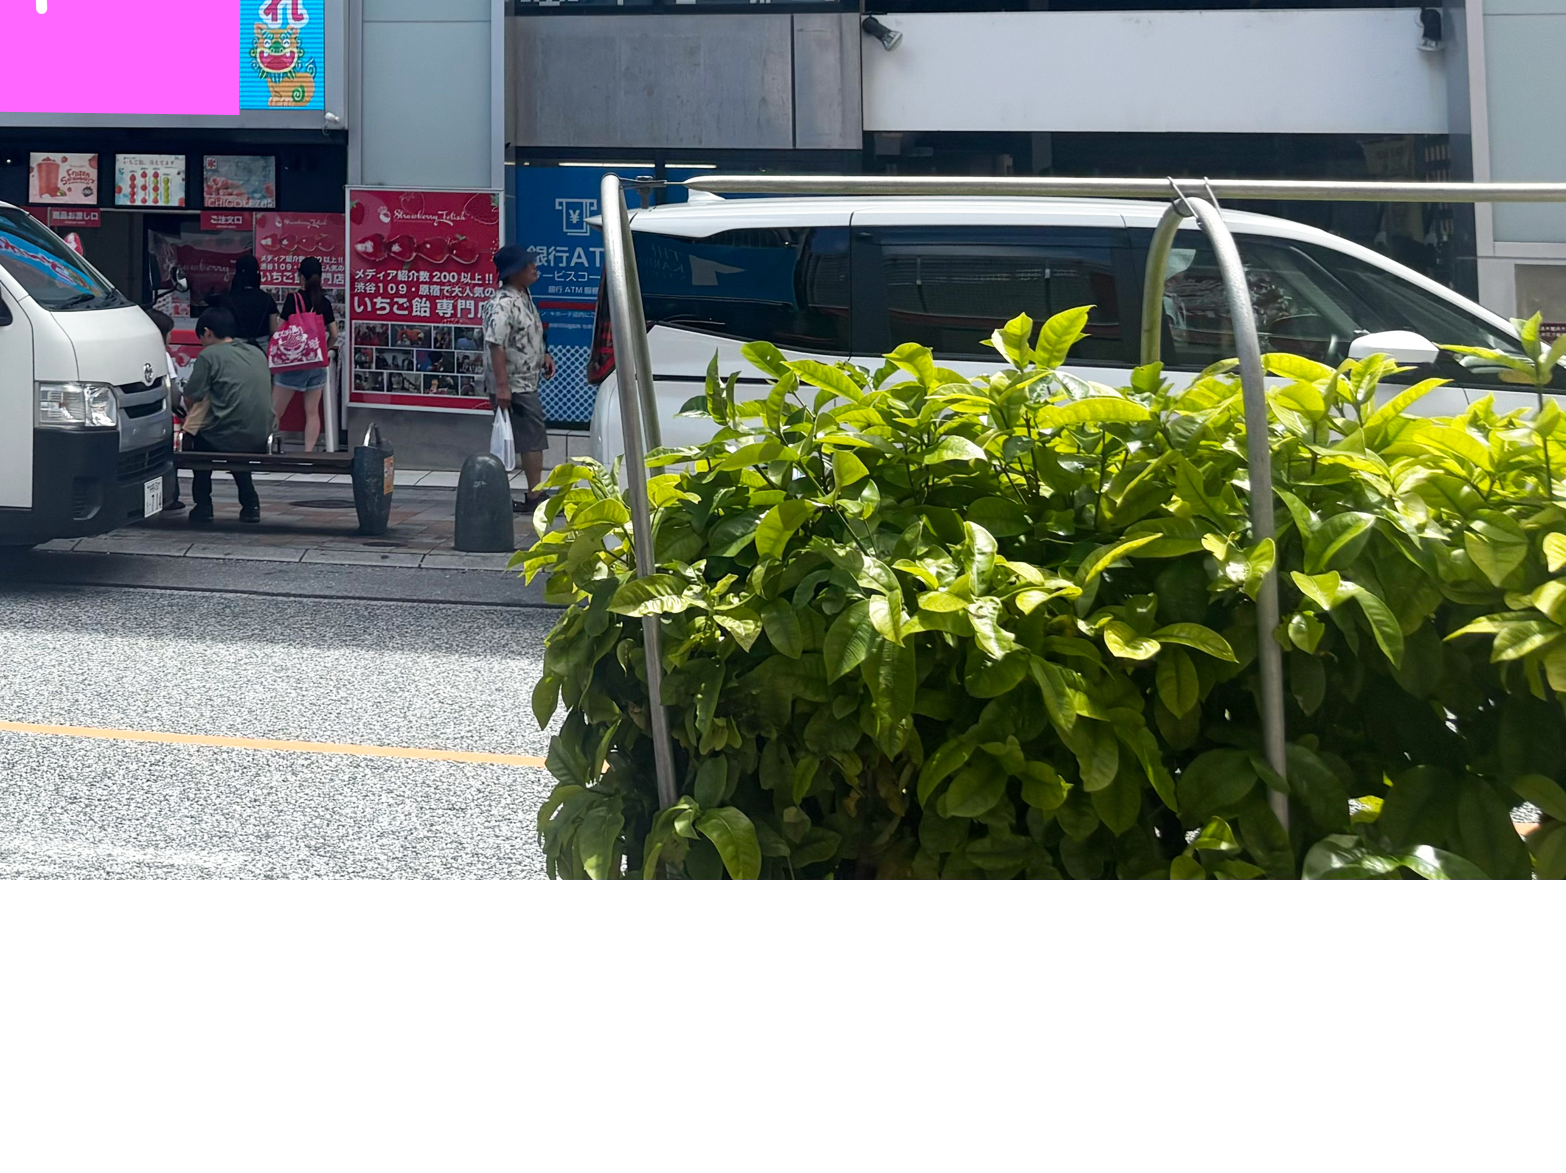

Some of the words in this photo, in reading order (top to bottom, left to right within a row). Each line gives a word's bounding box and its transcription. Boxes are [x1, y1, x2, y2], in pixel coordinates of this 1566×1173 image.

[210, 215, 243, 224] ご注文口
[393, 209, 438, 226] Strawberry
[527, 244, 605, 268] 銀行AT
[321, 273, 345, 285] 門店
[354, 268, 430, 282] メディア紹介数
[432, 271, 458, 283] 200
[460, 272, 483, 284] 以上
[353, 296, 431, 318] いちご飴
